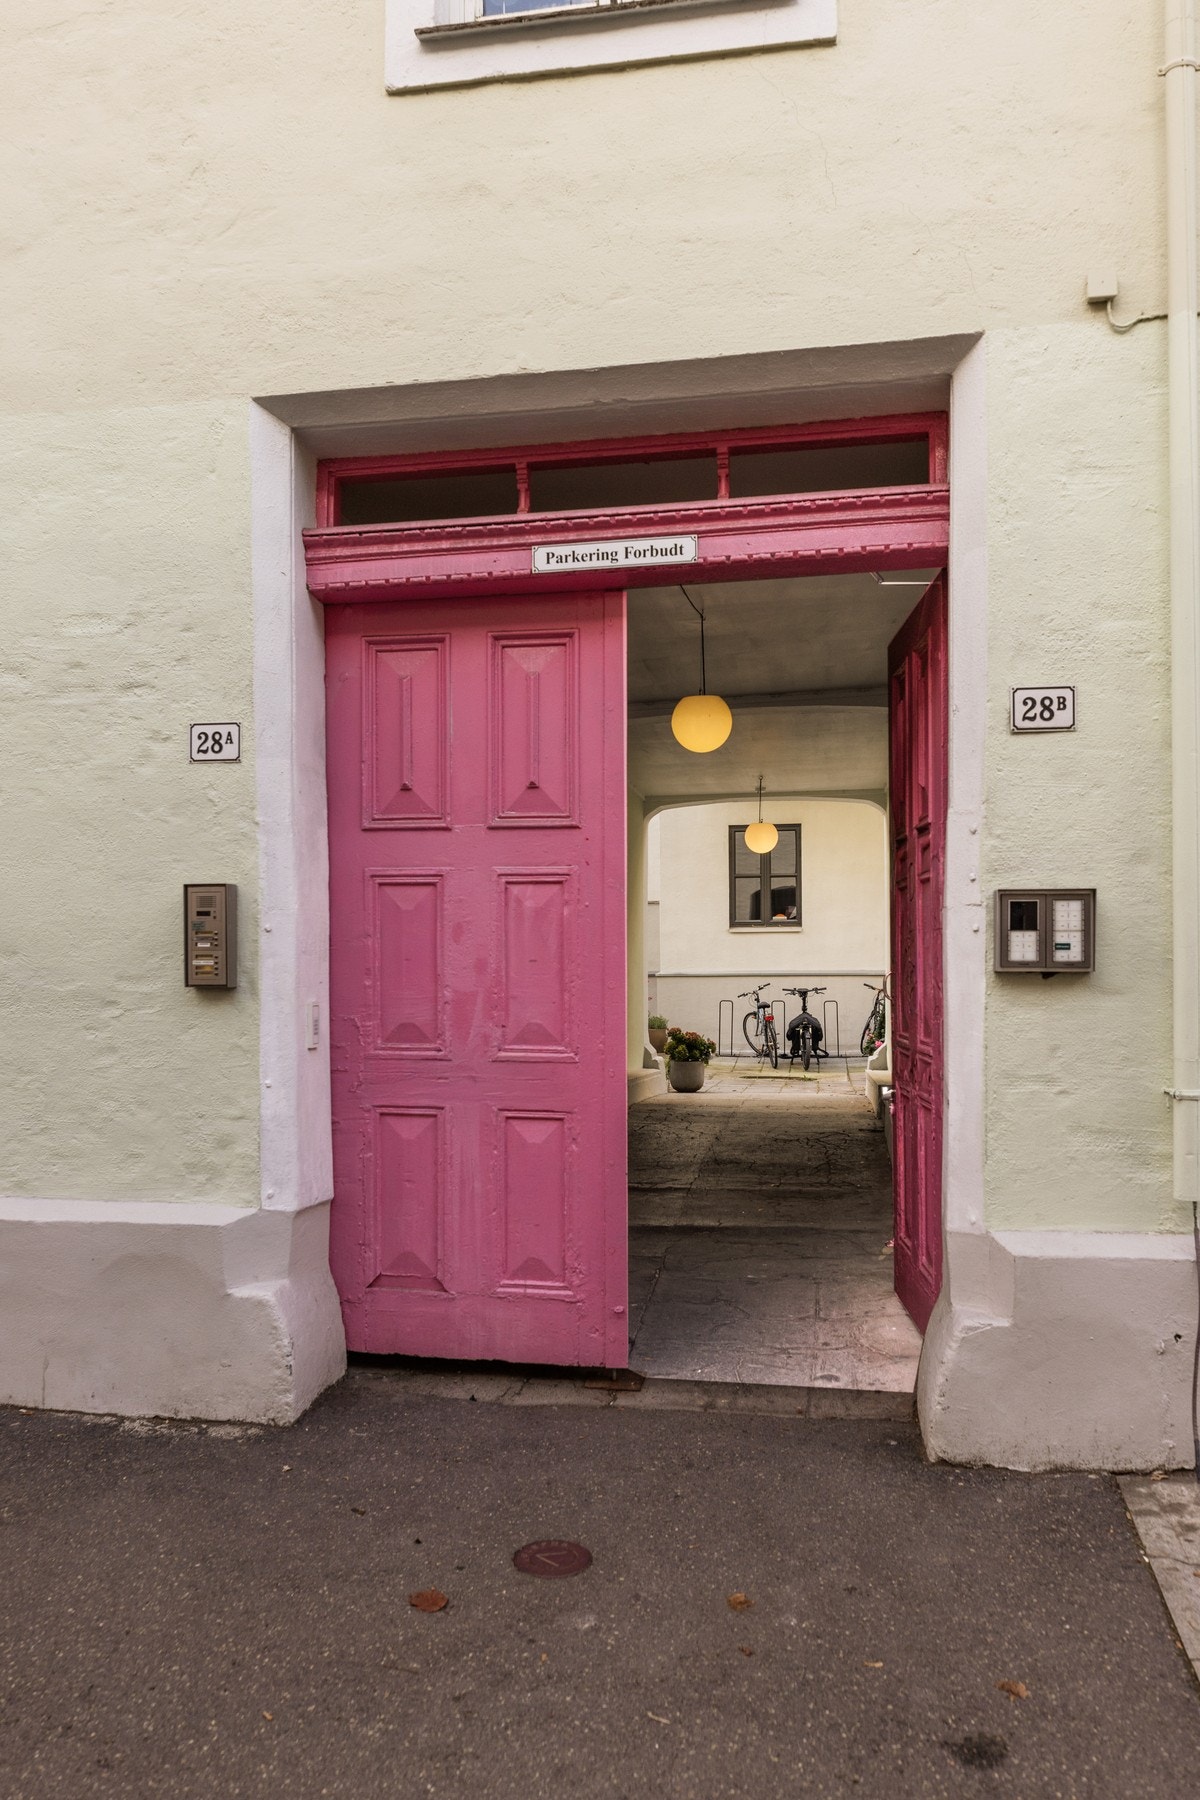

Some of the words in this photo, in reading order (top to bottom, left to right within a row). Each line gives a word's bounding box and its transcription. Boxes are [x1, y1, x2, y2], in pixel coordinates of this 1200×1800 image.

[546, 548, 618, 564] Parkering
[624, 543, 684, 559] Forbudt
[1022, 696, 1067, 721] 28B
[197, 731, 233, 754] 28A
